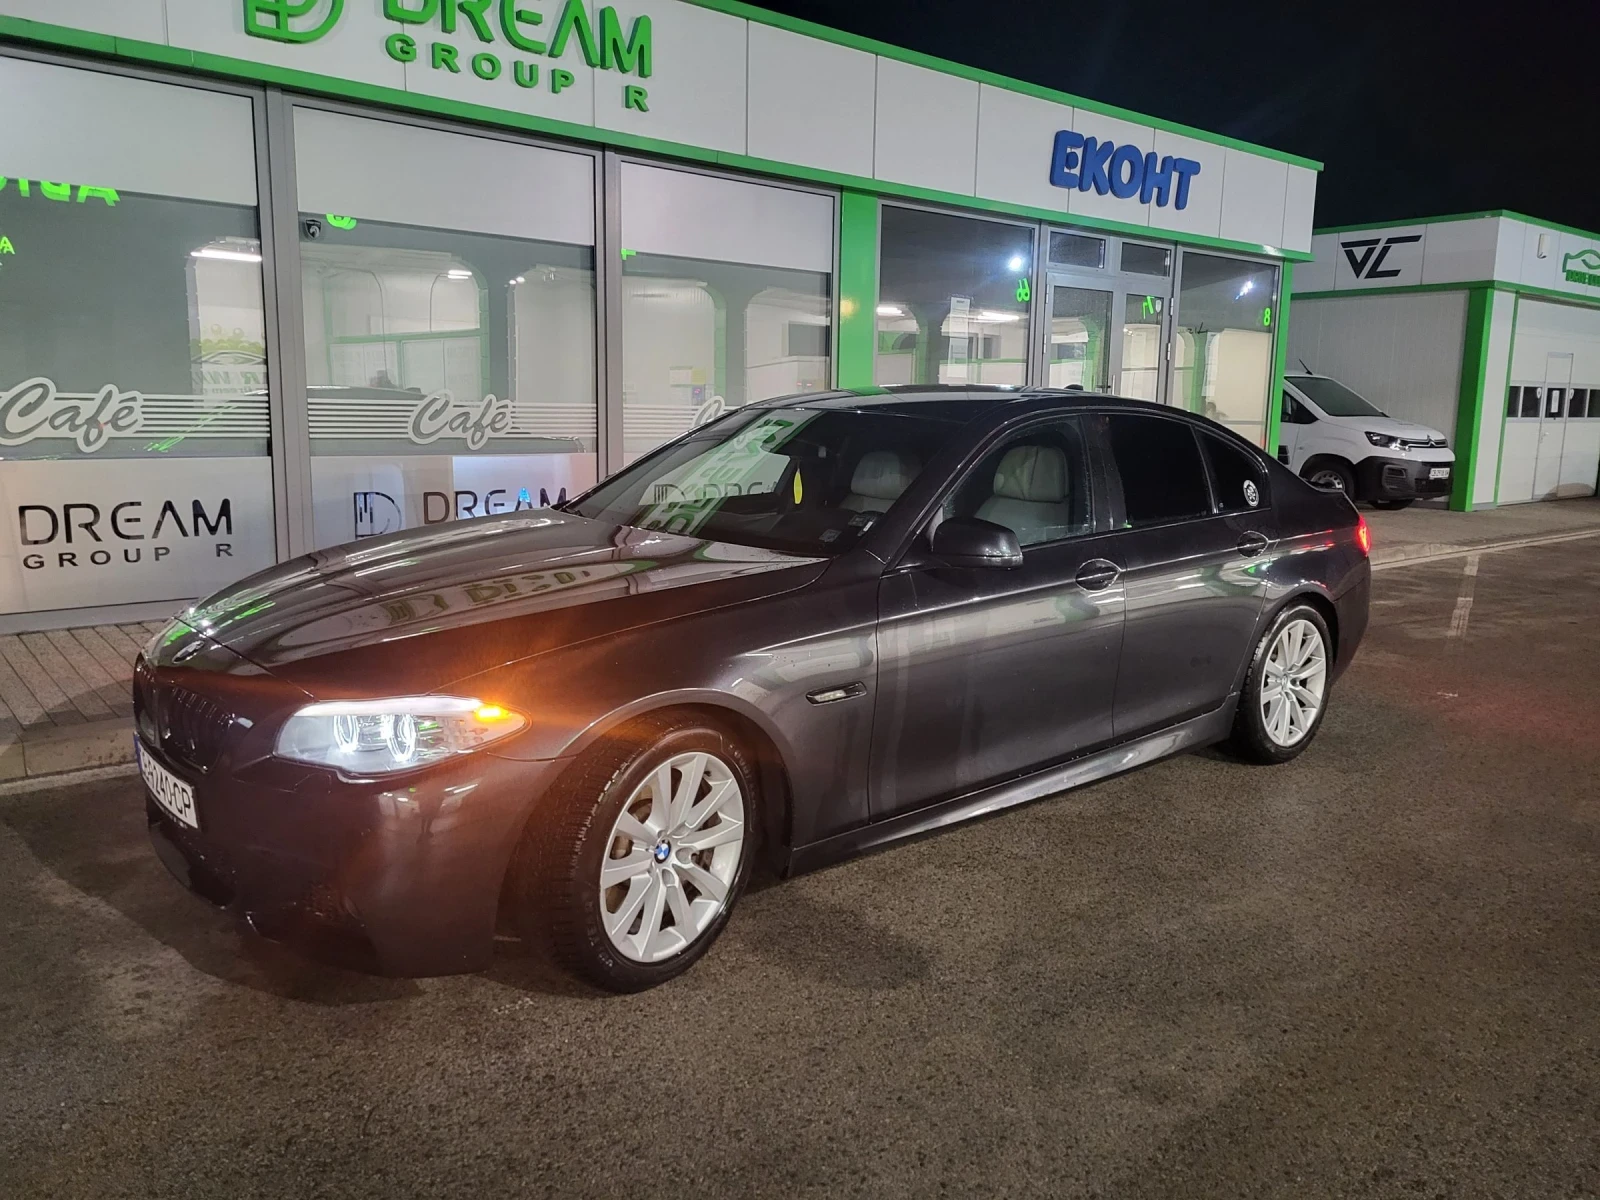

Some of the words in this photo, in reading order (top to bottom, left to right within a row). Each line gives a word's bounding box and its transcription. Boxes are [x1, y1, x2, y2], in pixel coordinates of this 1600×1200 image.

[385, 33, 575, 94] GROUP
[624, 85, 649, 112] R
[0, 383, 138, 447] Café
[412, 393, 508, 446] Café
[18, 498, 232, 545] DREAM
[23, 547, 170, 570] GROUP
[215, 543, 233, 557] R
